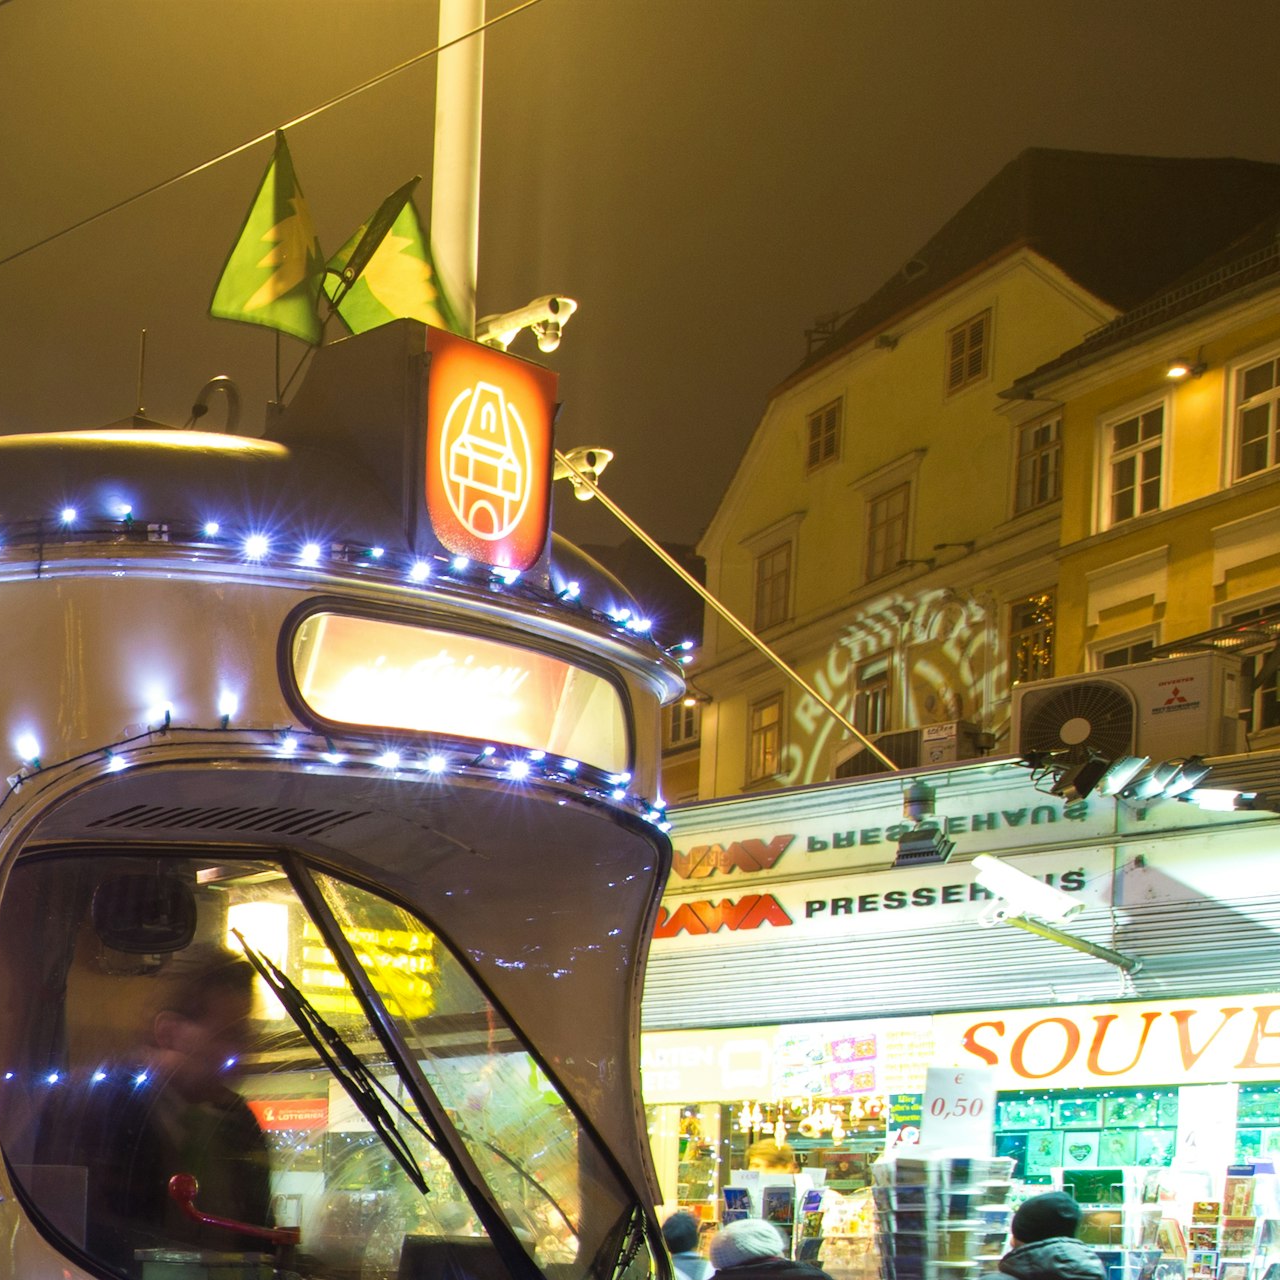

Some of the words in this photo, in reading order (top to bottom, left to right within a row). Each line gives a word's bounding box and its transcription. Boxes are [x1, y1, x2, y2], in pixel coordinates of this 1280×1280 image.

[805, 869, 1086, 920] PRESSEHS
[953, 1072, 965, 1085] €
[930, 1097, 984, 1120] 0,50
